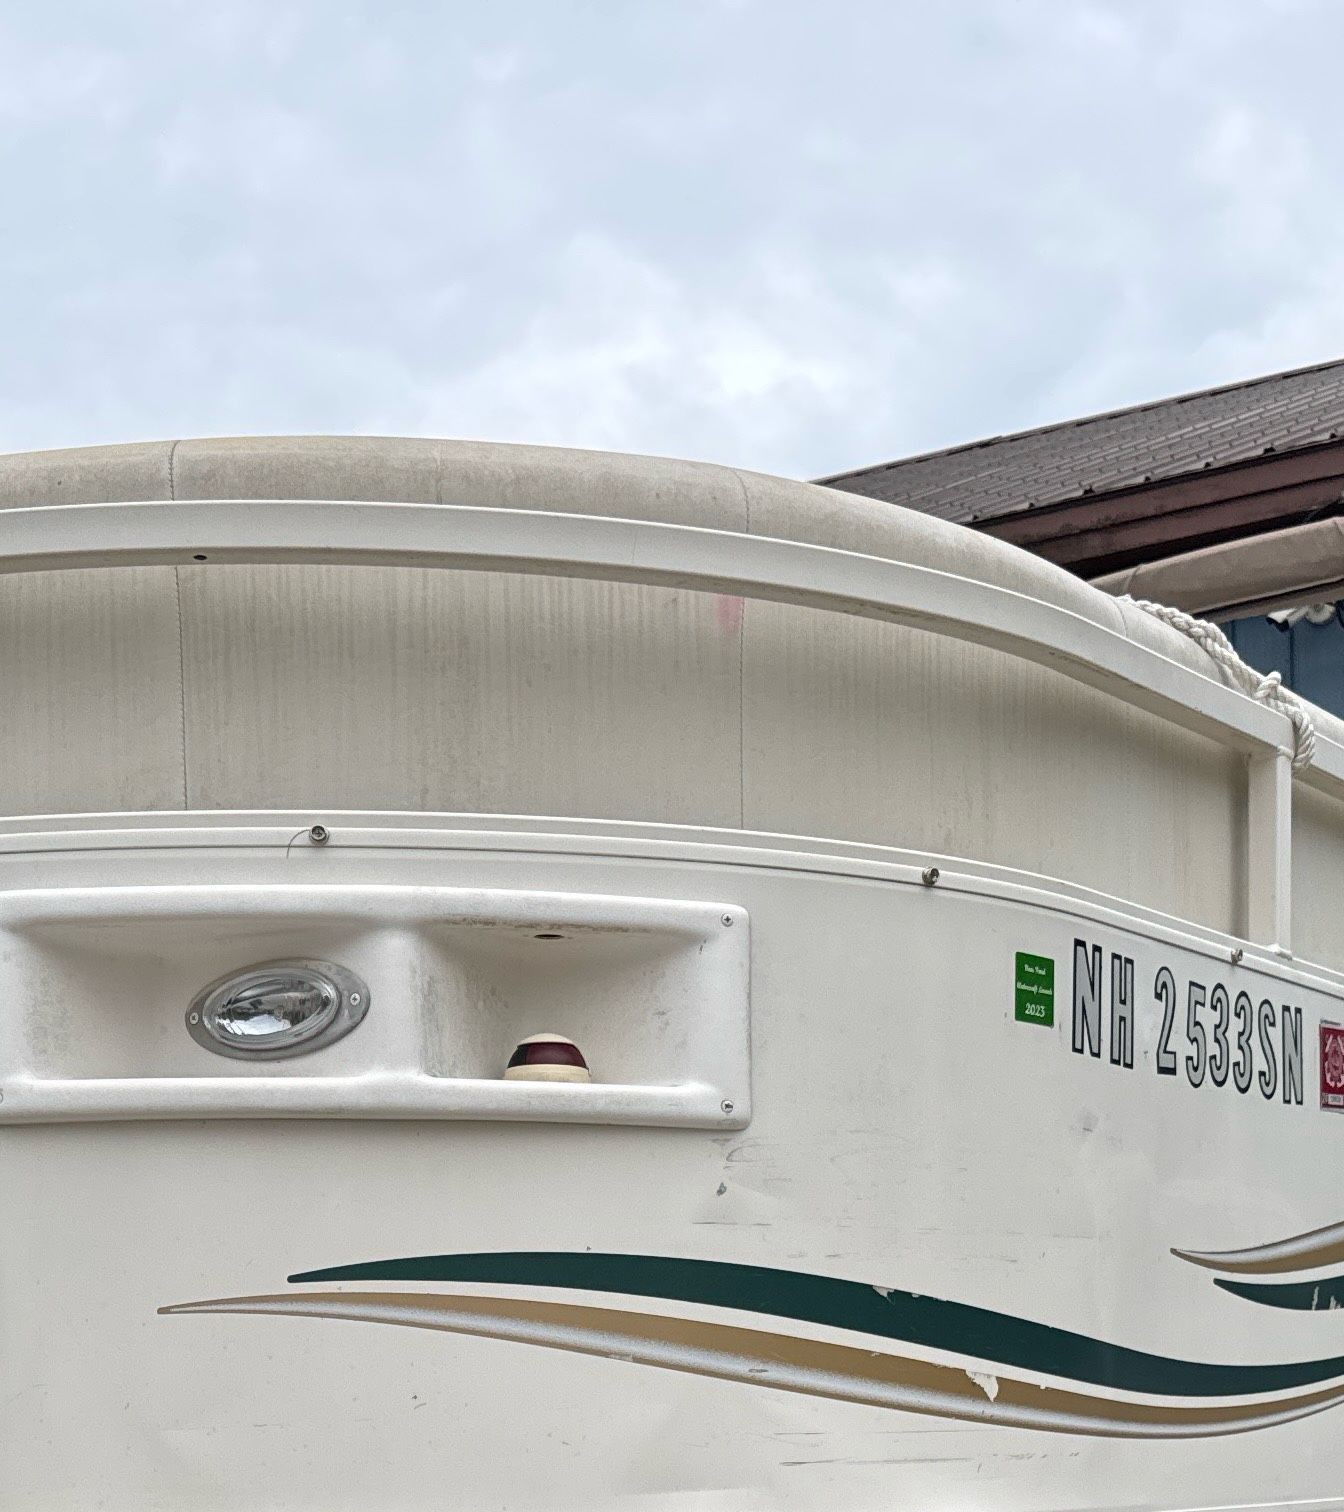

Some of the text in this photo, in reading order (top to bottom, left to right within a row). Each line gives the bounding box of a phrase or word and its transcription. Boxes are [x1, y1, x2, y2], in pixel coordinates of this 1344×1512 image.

[1024, 1002, 1046, 1018] 2023
[1070, 937, 1304, 1105] NH 2533SN
